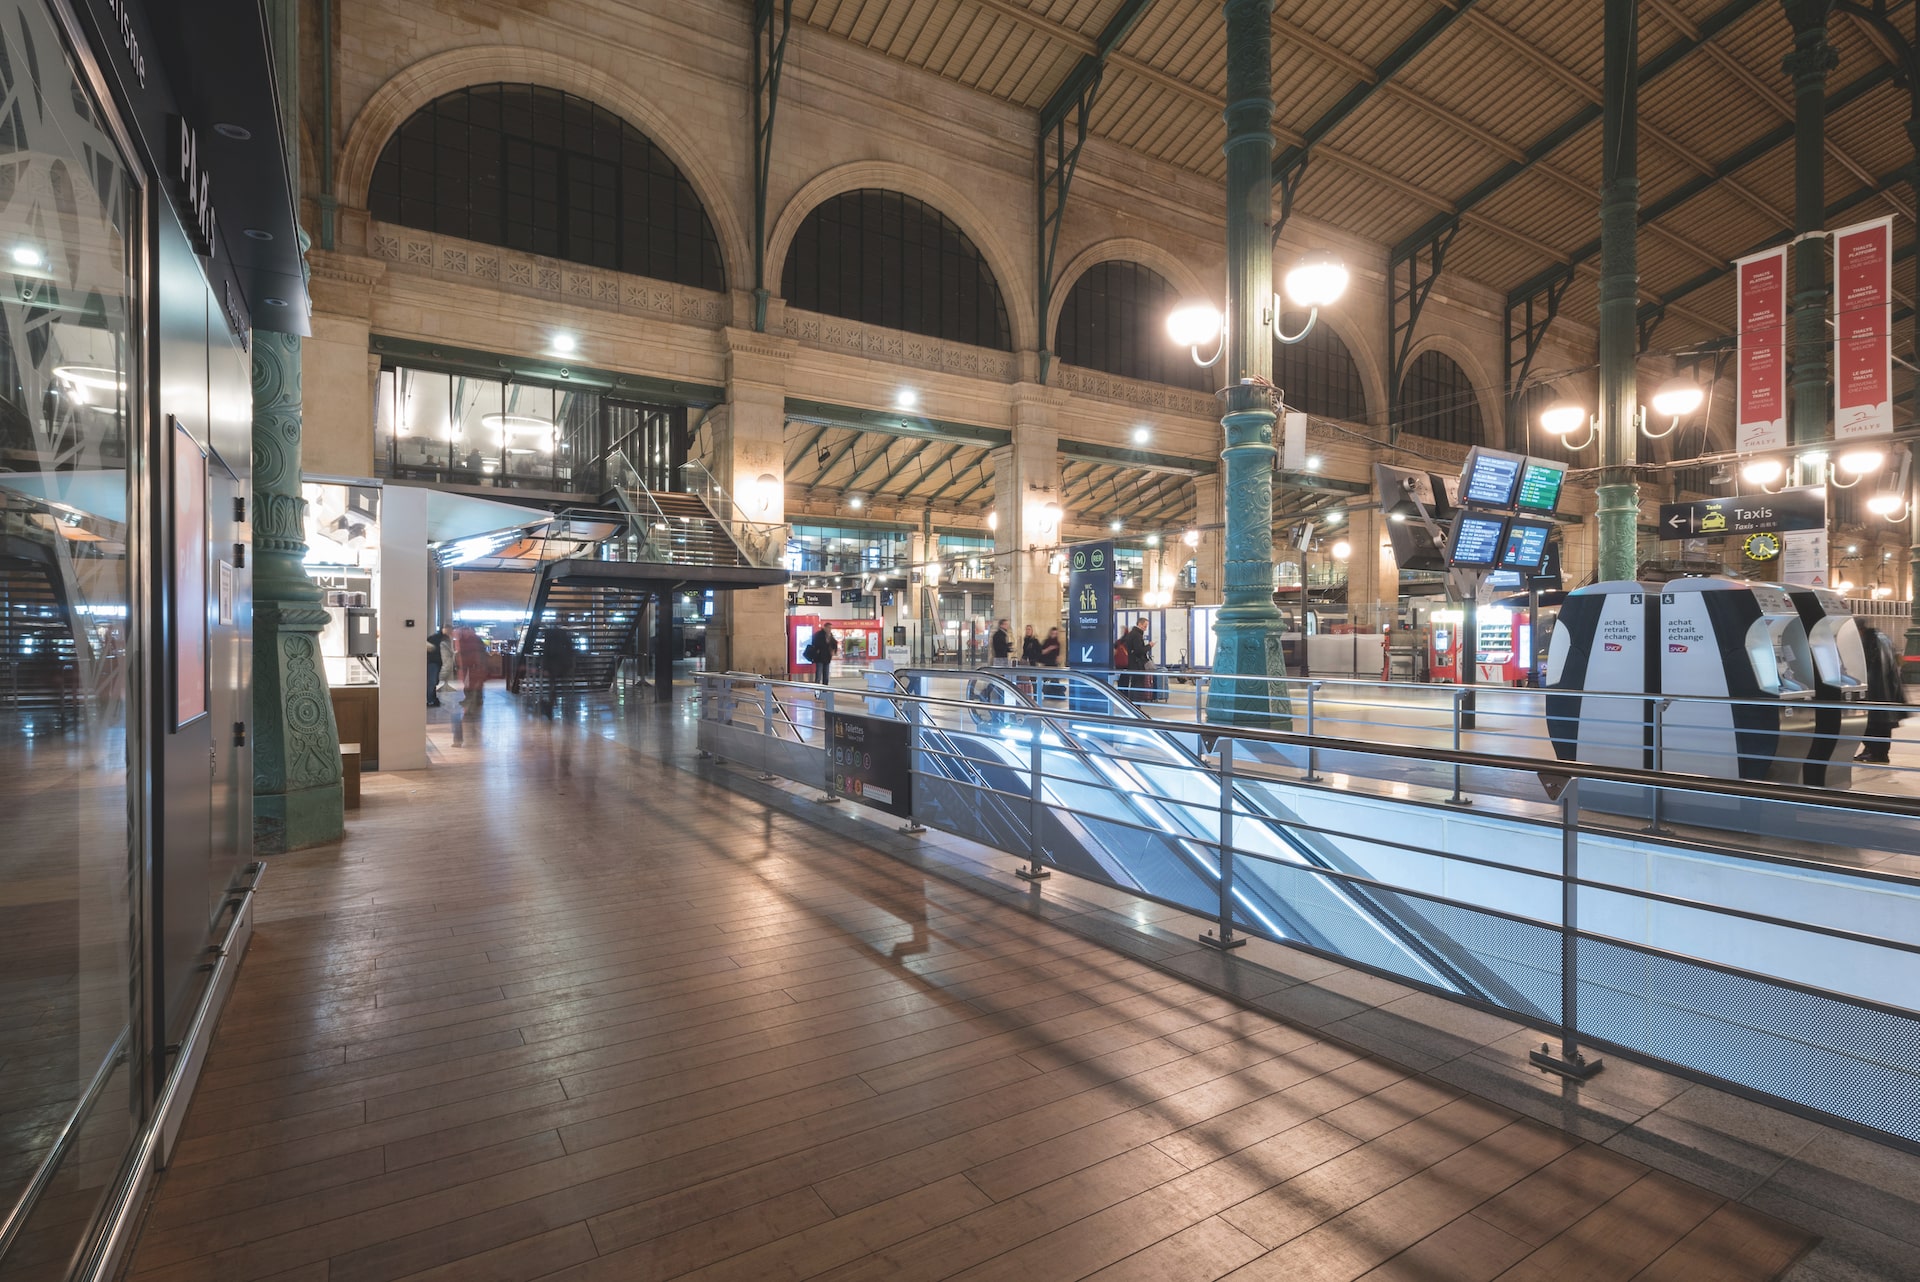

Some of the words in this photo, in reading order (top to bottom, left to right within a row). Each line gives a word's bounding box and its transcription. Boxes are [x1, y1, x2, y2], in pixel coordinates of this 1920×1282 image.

[1853, 243, 1872, 252] THALYS
[1849, 247, 1877, 258] PLATFORM
[1853, 285, 1872, 293] THALYS
[1845, 423, 1880, 433] THALYS
[1745, 438, 1776, 447] THALYS
[1734, 506, 1773, 520] Taxis
[1734, 523, 1754, 531] Taxis
[1604, 633, 1637, 641] échange
[1668, 633, 1704, 642] échange
[844, 722, 864, 735] Toilettes
